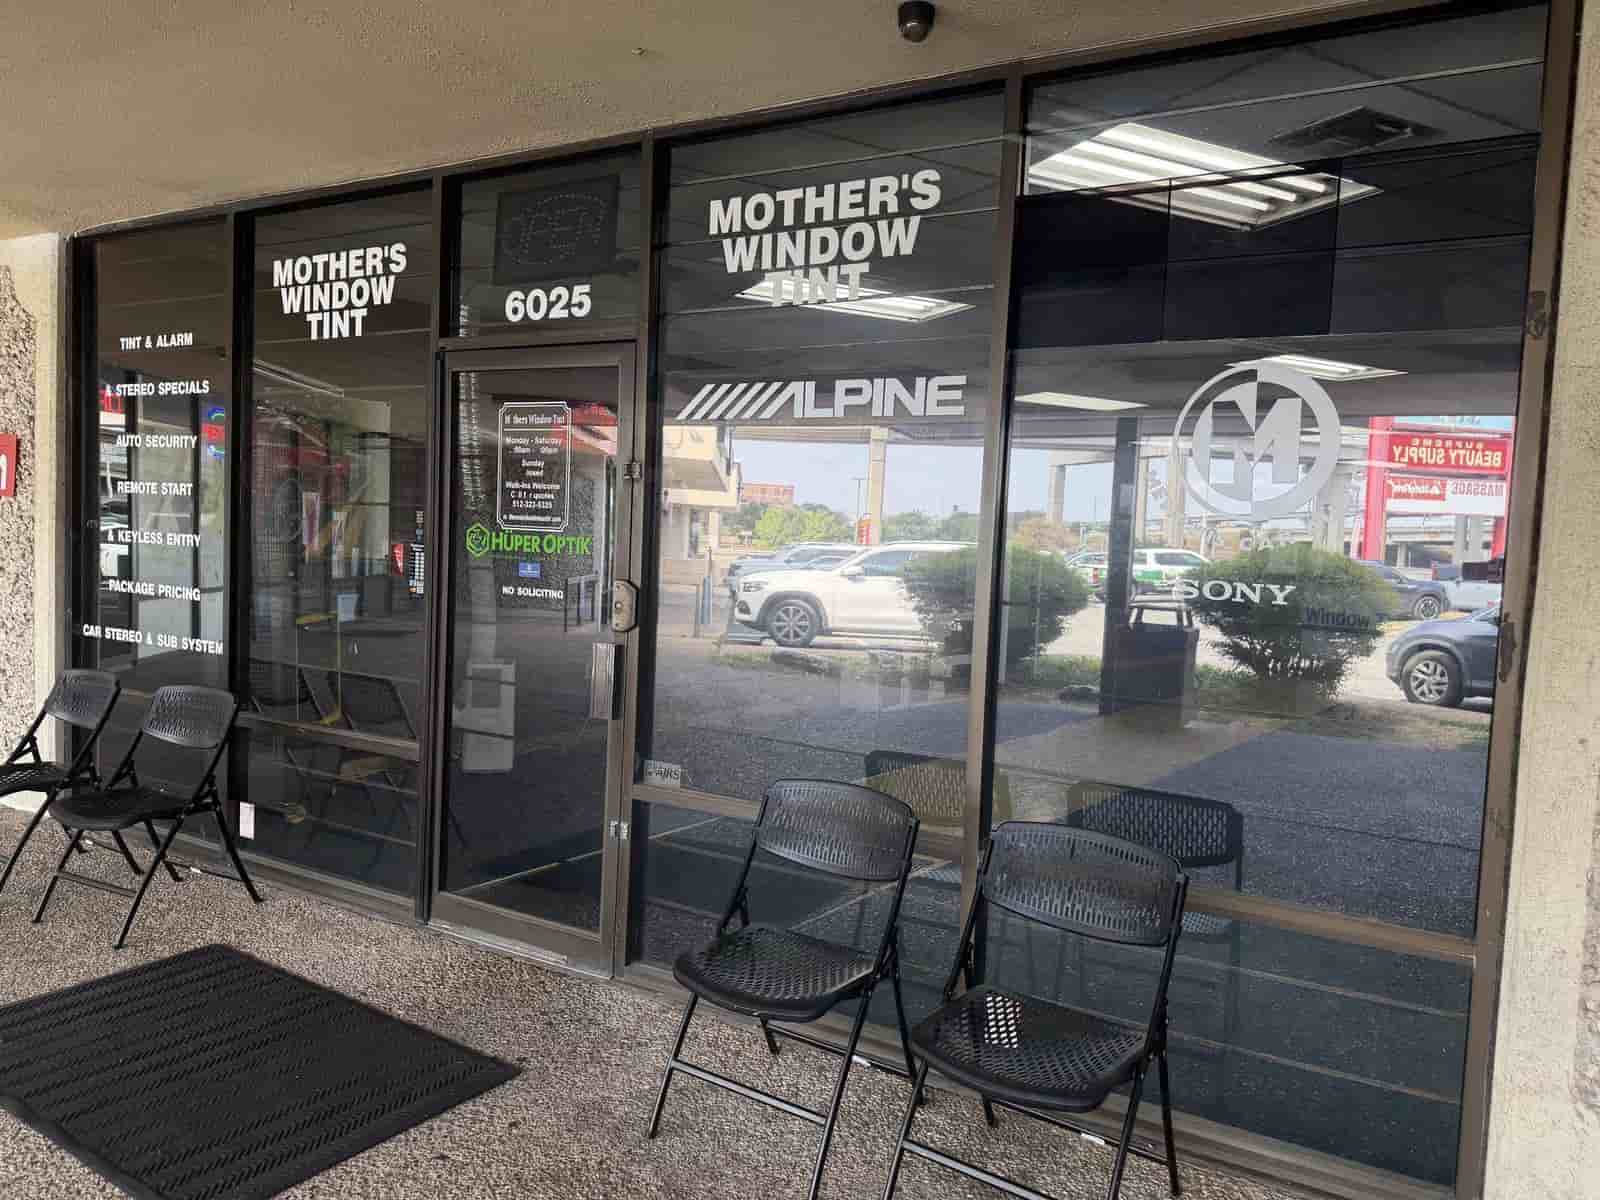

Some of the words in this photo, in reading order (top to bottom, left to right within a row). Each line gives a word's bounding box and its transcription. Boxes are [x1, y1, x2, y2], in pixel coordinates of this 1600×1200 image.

[708, 169, 941, 235] MOTHER'S
[722, 216, 920, 273] WINDOW
[273, 243, 407, 287] MOTHER'S
[281, 275, 395, 314] WINDOW
[765, 262, 869, 307] TINT
[505, 284, 592, 322] 6025
[306, 308, 368, 340] TINT
[120, 336, 142, 350] TINT
[145, 335, 152, 348] &
[156, 332, 193, 347] ALARM
[116, 382, 155, 397] STEREO
[158, 380, 210, 395] SPECIALS
[757, 375, 967, 419] ALPINE
[116, 434, 142, 448] AUTO
[146, 434, 198, 449] SECURITY
[117, 481, 157, 494] REMOTE
[161, 482, 193, 496] START
[118, 530, 163, 545] KEYLESS
[167, 533, 201, 547] ENTRY
[491, 530, 541, 553] HÜPER
[543, 534, 592, 555] OPTIK
[108, 579, 155, 596] PACKAGE
[159, 585, 201, 601] PRICING
[502, 585, 514, 595] NO
[517, 587, 564, 600] SOLICITING
[1173, 579, 1296, 605] SONY
[83, 624, 102, 638] CAR
[105, 627, 142, 643] STEREO
[157, 634, 178, 648] SUB
[182, 637, 224, 655] SYSTEM
